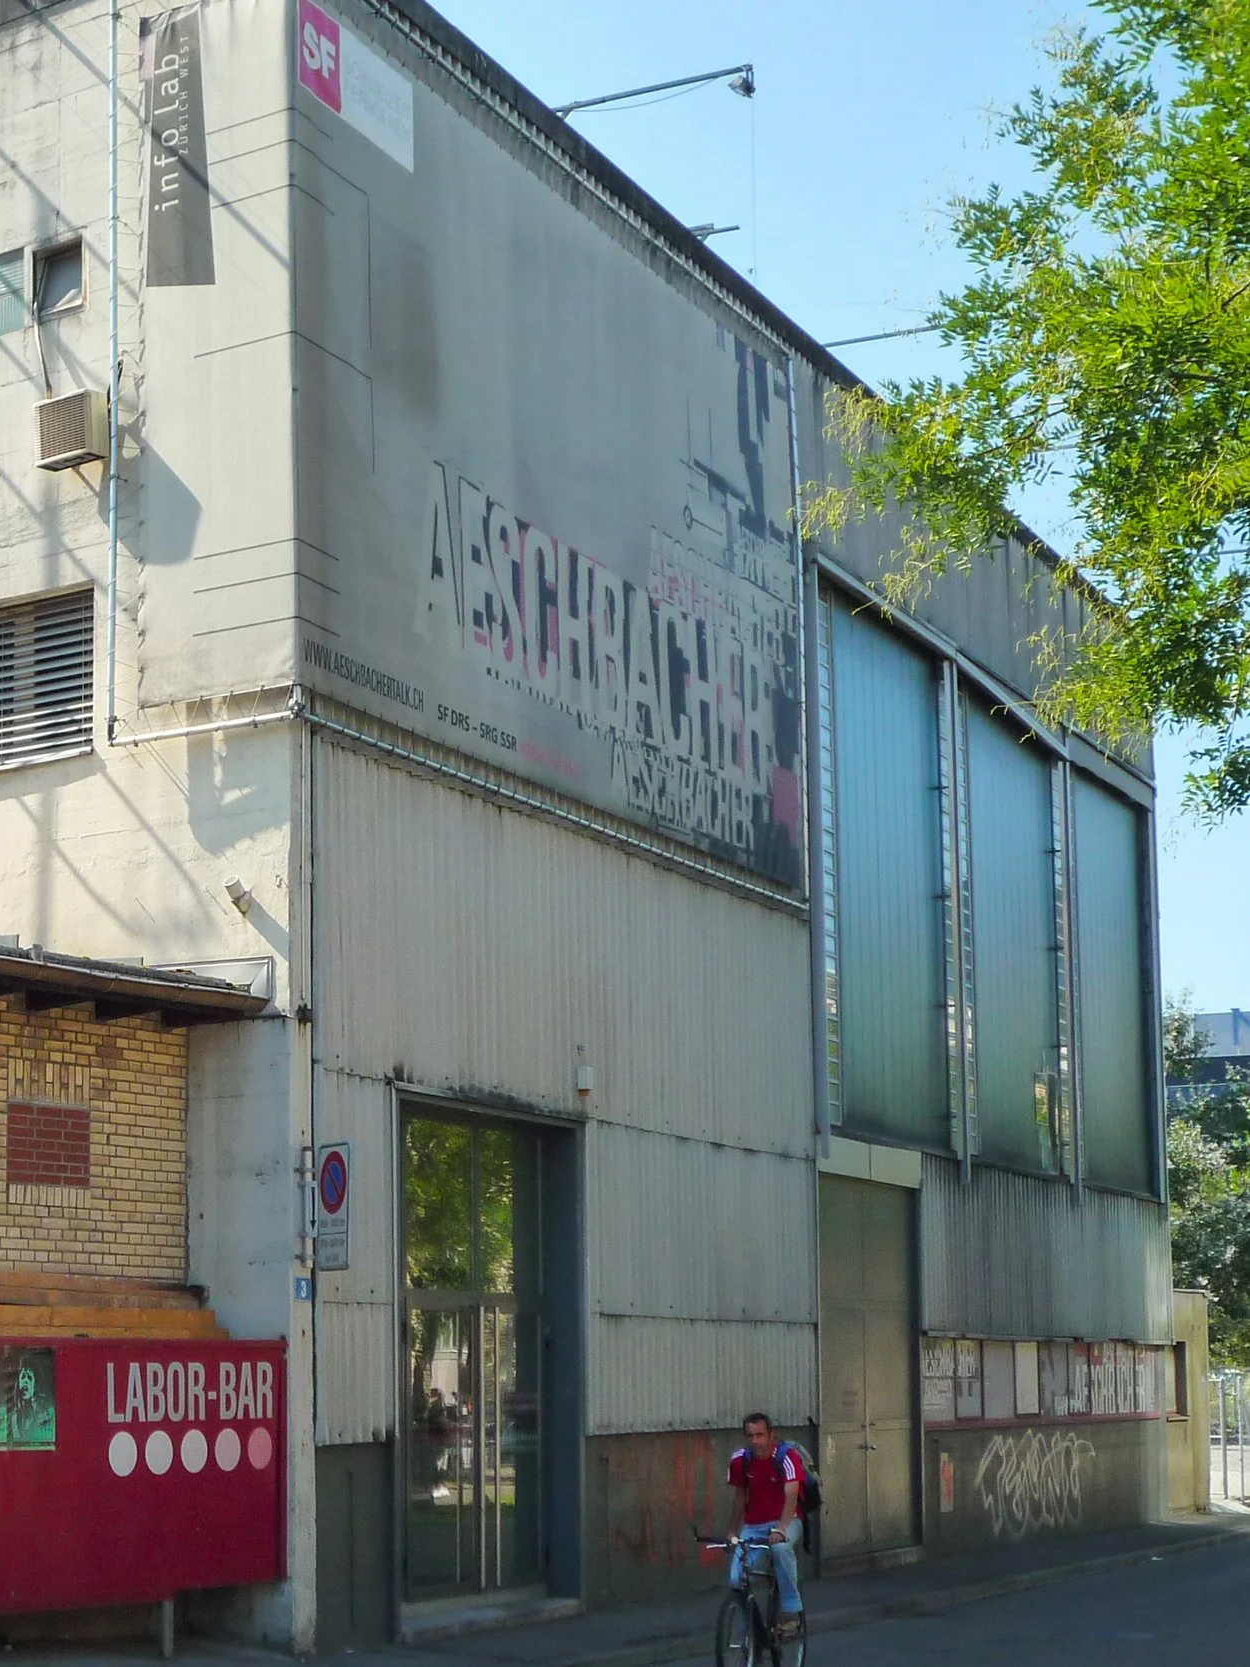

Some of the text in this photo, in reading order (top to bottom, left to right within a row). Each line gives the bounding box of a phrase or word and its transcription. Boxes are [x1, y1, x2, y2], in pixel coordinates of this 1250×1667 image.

[179, 35, 190, 80] WEST
[302, 21, 337, 80] SF
[154, 52, 180, 212] info lab
[303, 636, 425, 713] WWW.AESCHBACHERTALK.CH
[437, 703, 450, 721] SF
[450, 709, 470, 732] DRS
[479, 721, 498, 745] SRG
[500, 730, 518, 752] SSR
[300, 1280, 307, 1298] 3
[106, 1361, 274, 1424] LABOR-BAR
